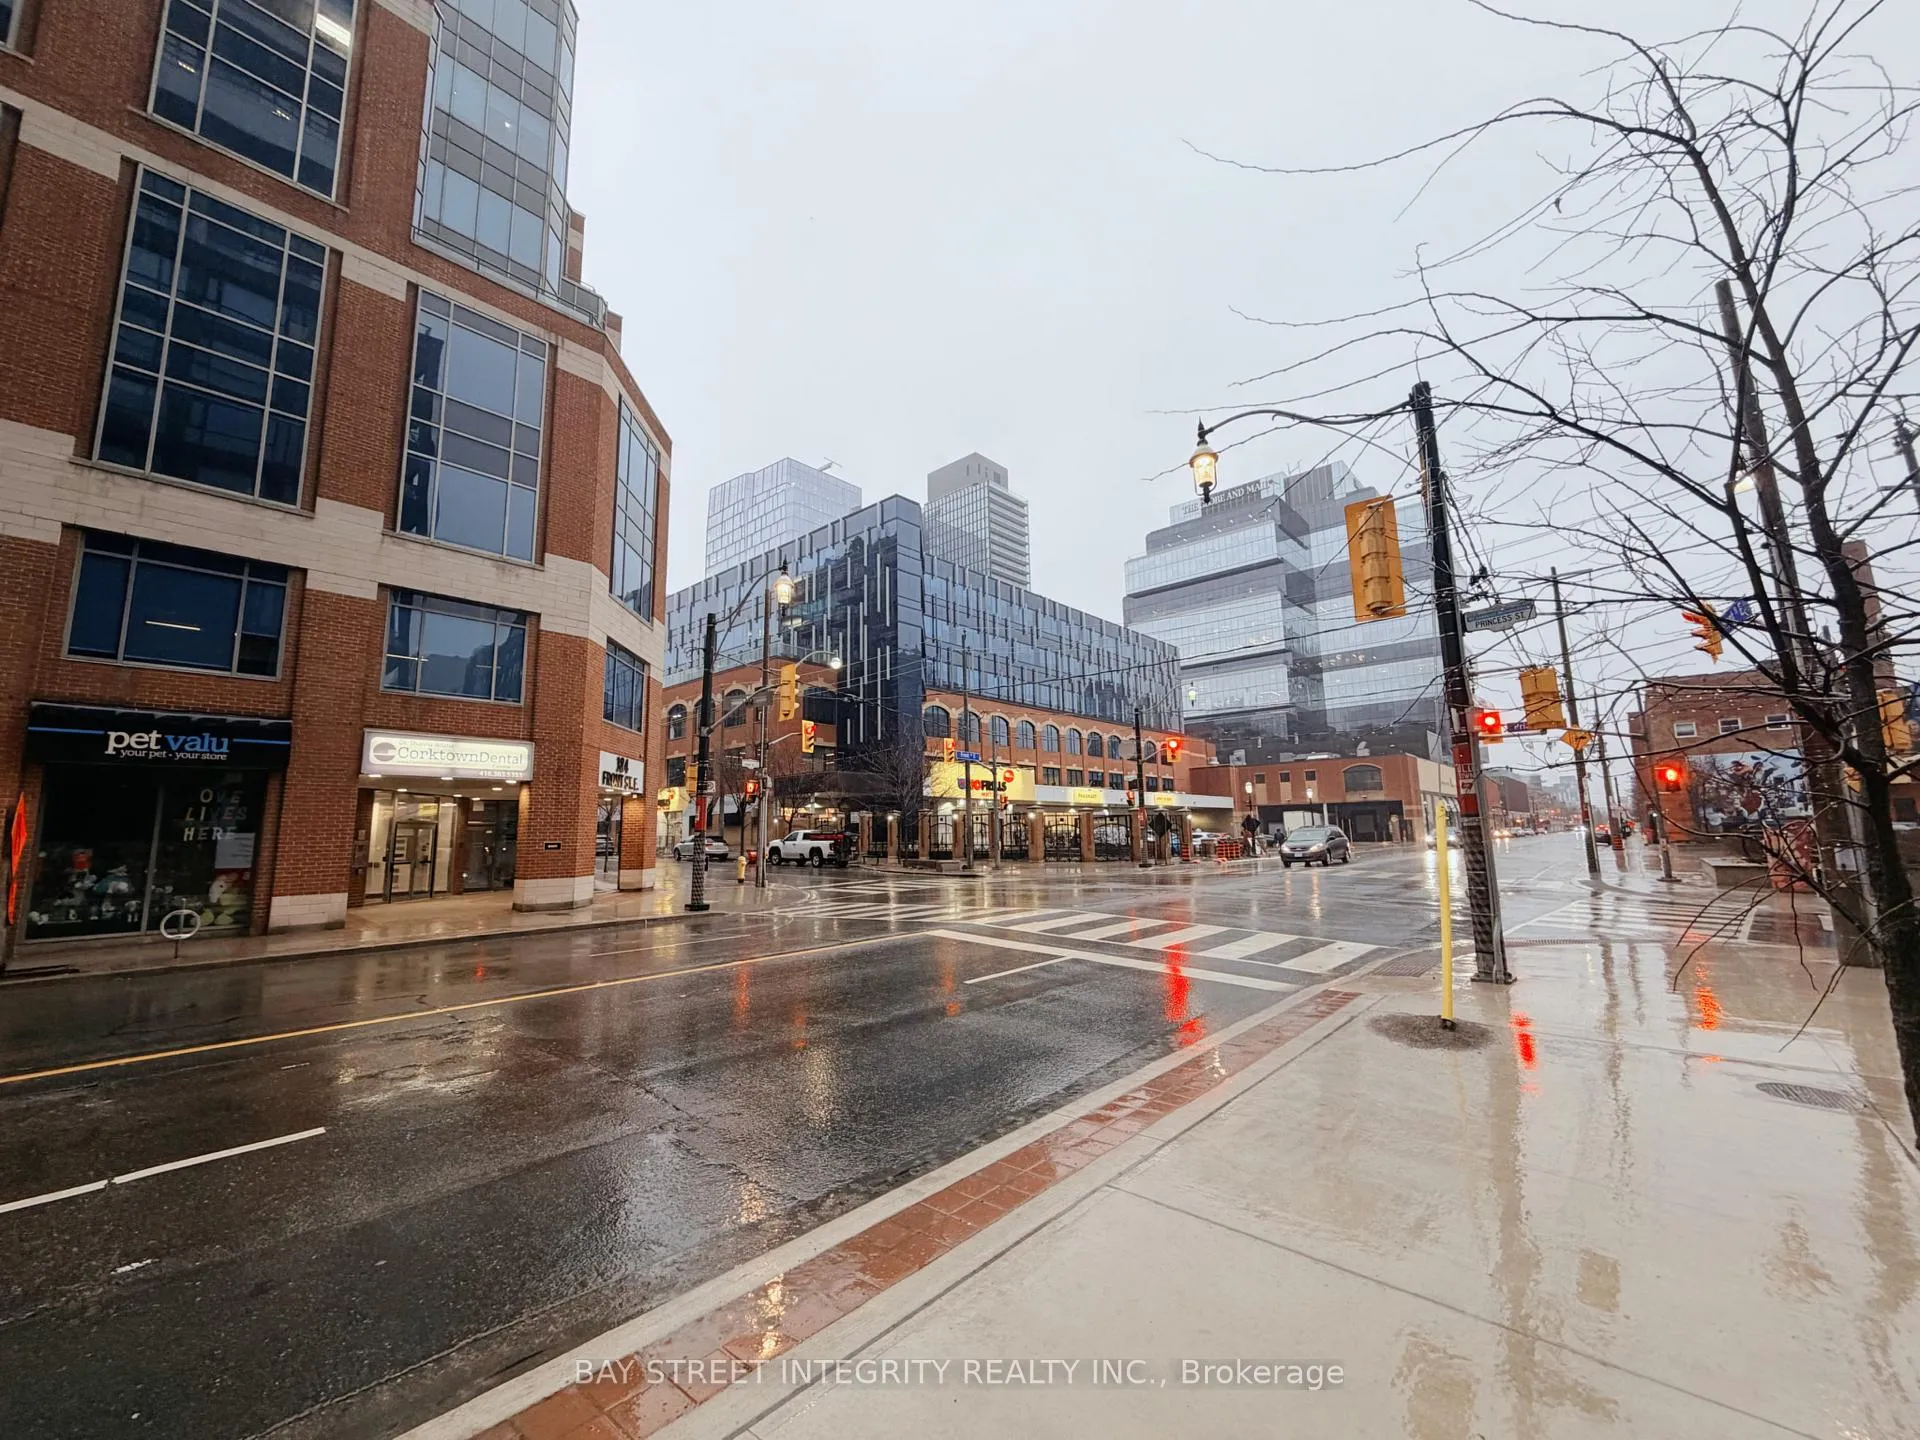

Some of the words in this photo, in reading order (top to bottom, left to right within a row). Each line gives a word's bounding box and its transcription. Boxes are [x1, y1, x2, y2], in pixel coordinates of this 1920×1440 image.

[1226, 487, 1245, 501] AND
[1475, 614, 1513, 628] PRINCESS
[1515, 611, 1526, 619] ST
[104, 729, 162, 755] pet
[164, 732, 229, 753] valu
[120, 749, 147, 758] your
[148, 750, 167, 759] pet
[174, 751, 201, 761] your
[201, 752, 228, 760] store
[183, 826, 237, 841] HERE
